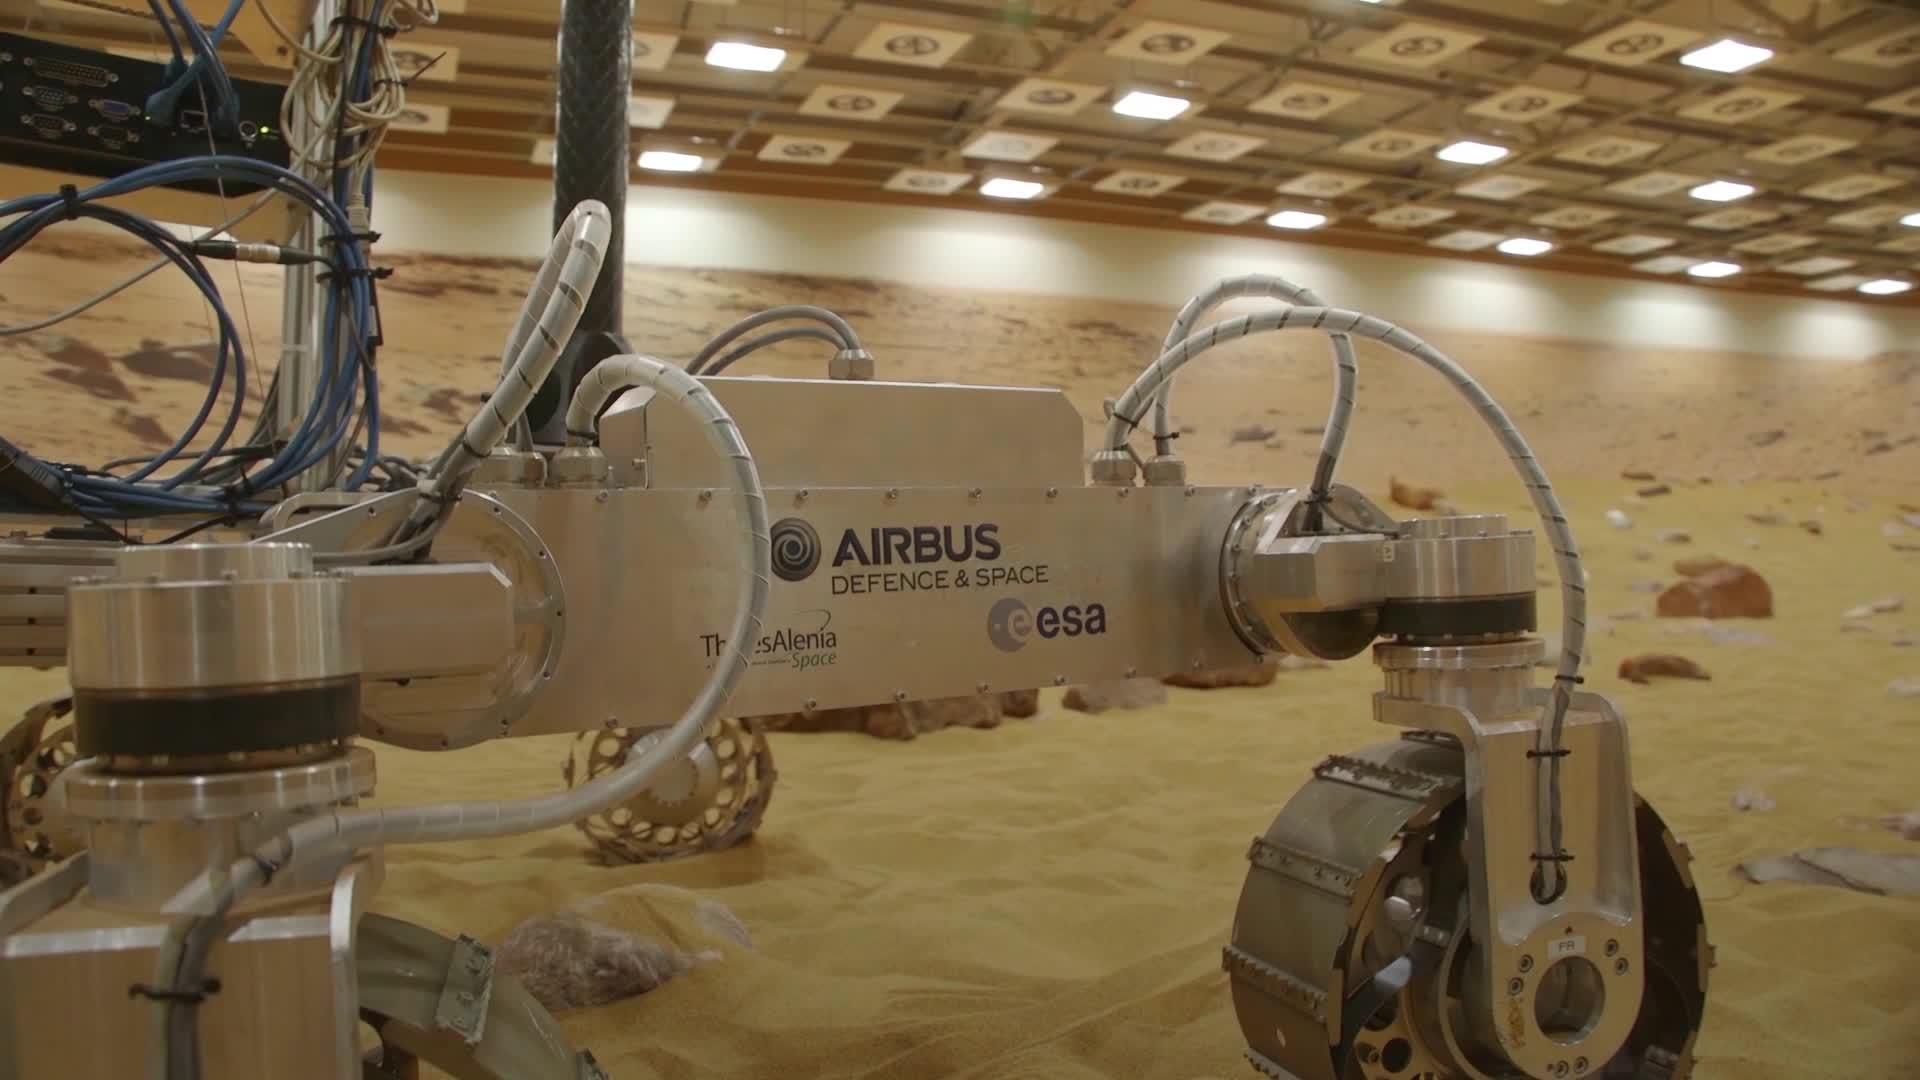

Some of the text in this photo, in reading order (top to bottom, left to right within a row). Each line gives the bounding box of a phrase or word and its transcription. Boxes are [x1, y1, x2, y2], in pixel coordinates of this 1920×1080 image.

[832, 523, 1002, 567] AIRBUS
[831, 564, 1049, 595] DEFENCE & SPACE
[1036, 603, 1107, 639] esa
[699, 627, 837, 657] ThsAlenia
[791, 652, 837, 672] Space
